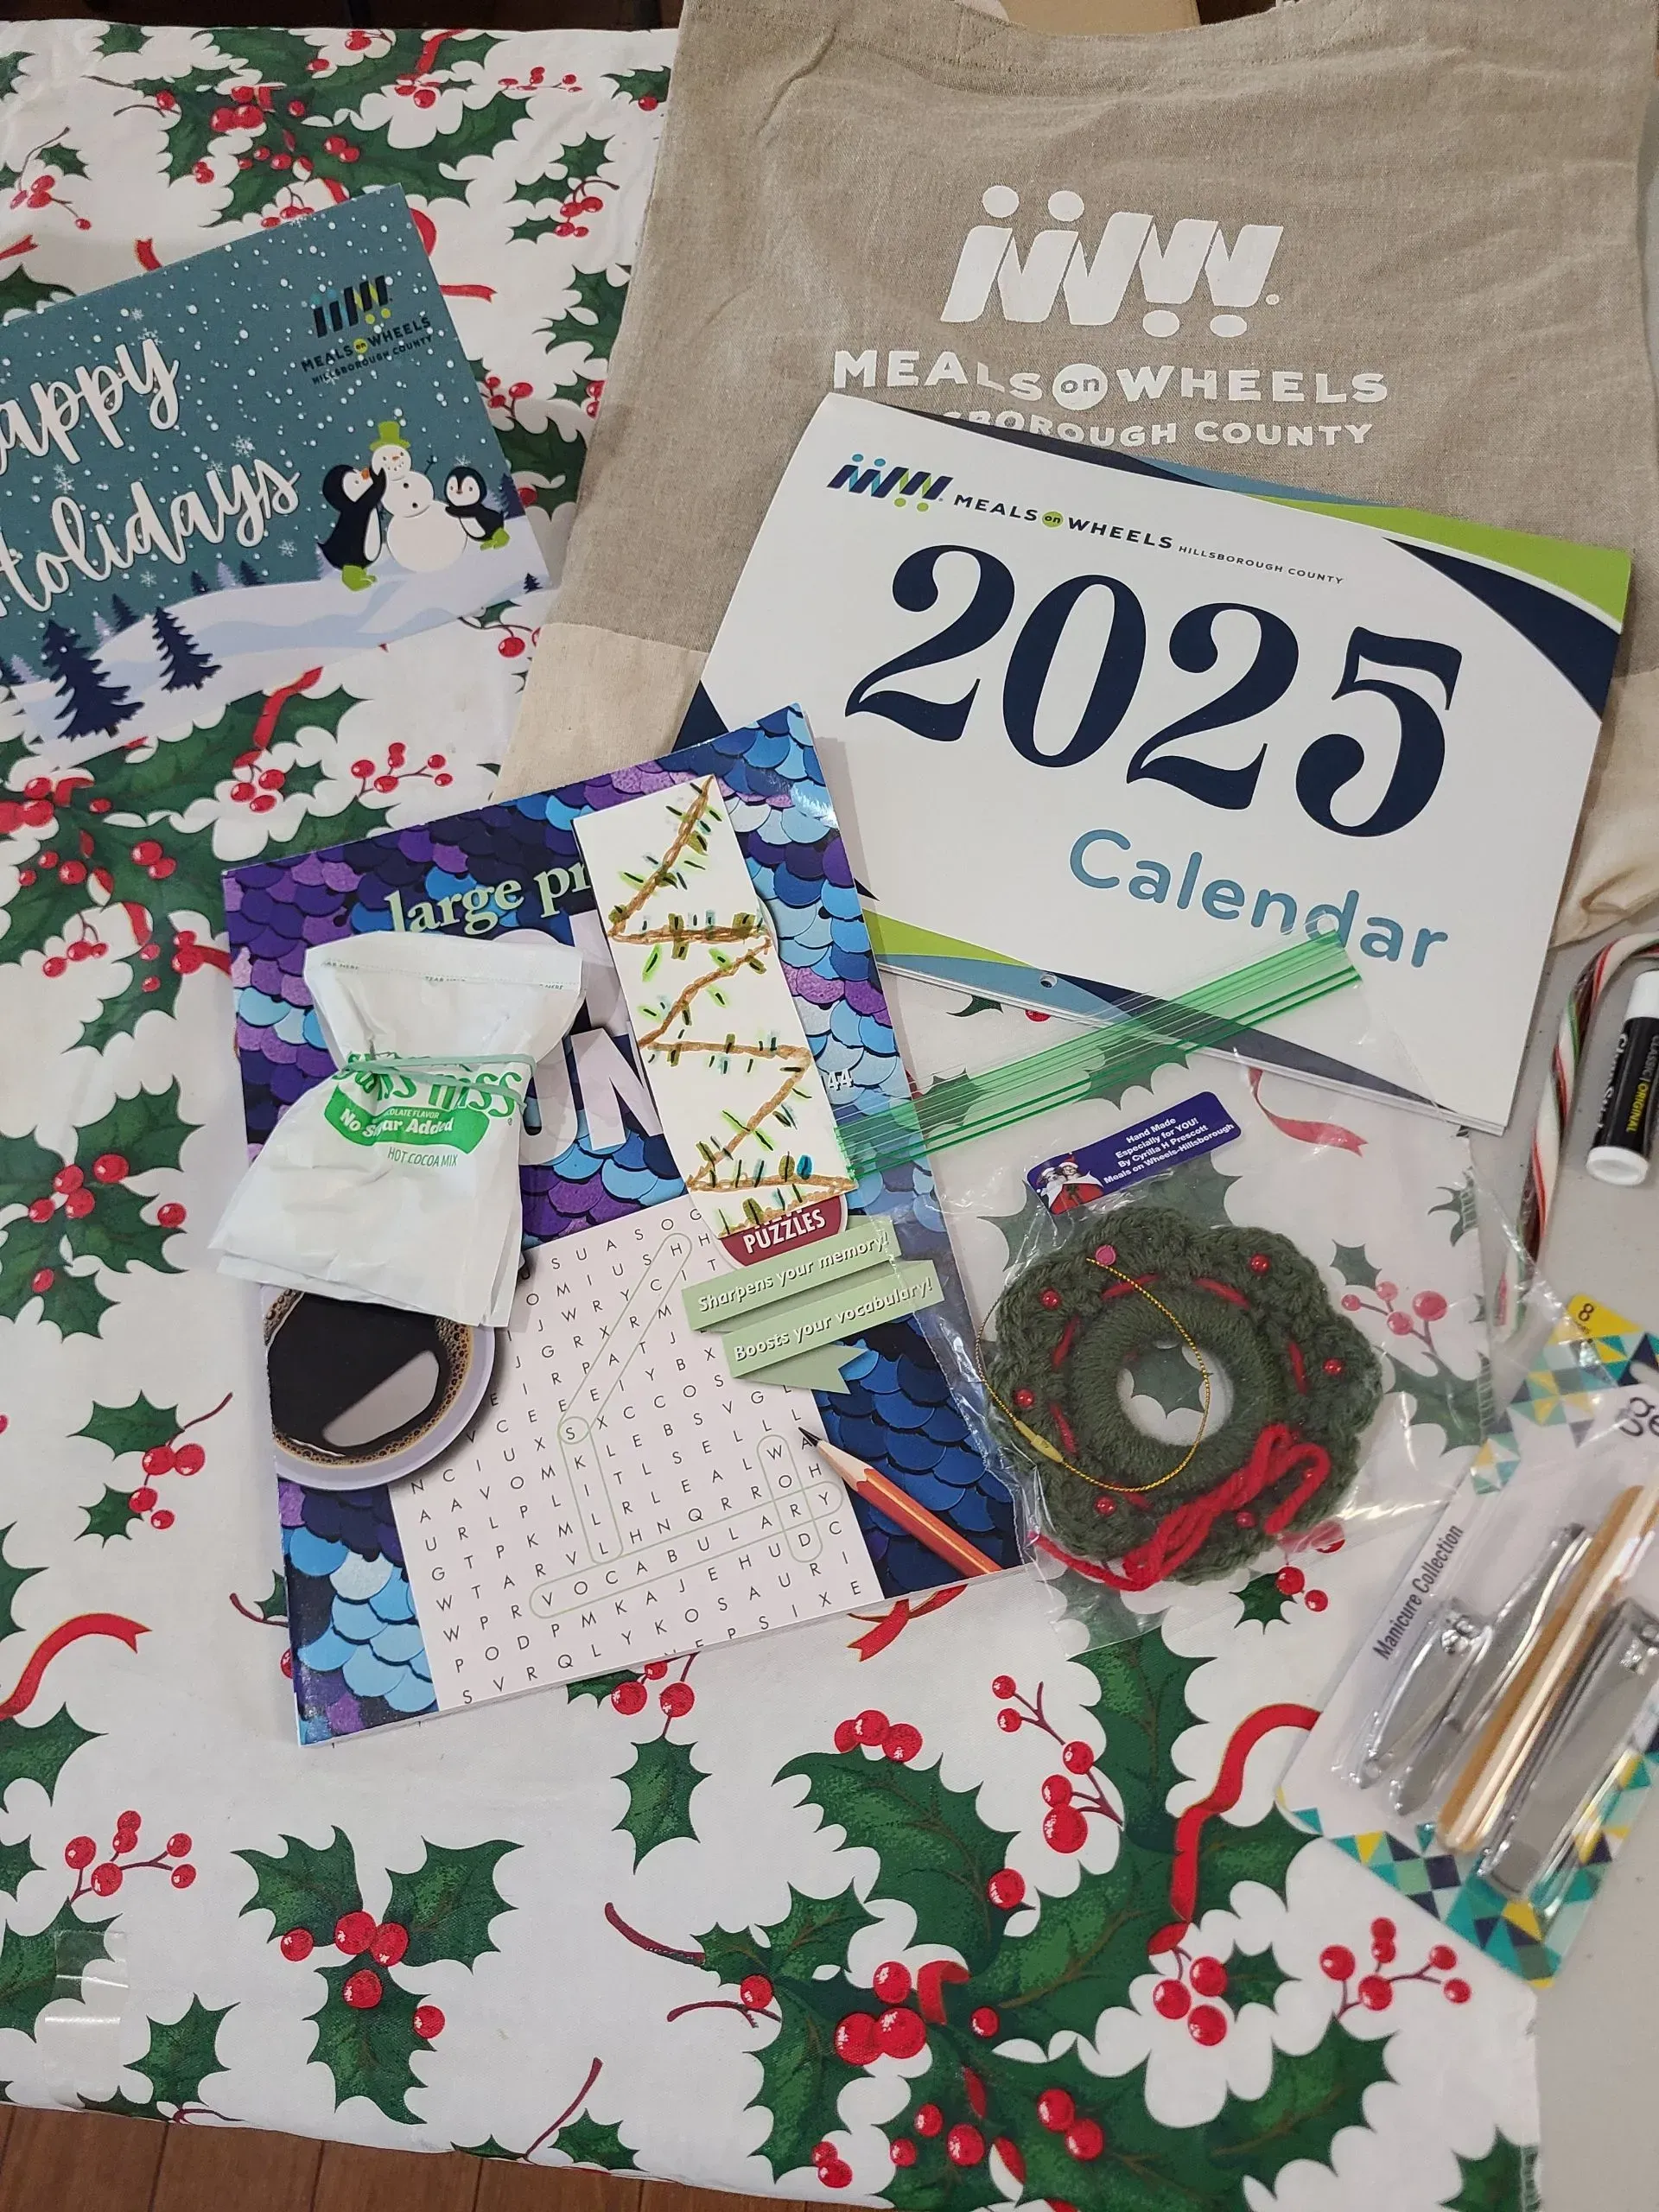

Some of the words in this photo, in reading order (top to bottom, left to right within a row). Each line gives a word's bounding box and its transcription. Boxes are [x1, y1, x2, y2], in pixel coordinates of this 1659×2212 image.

[301, 346, 353, 372] MEALS
[367, 316, 431, 347] WHEELS
[392, 334, 433, 355] COUNTY
[0, 338, 180, 476] appy
[833, 349, 1043, 401] MEALS
[1059, 377, 1101, 394] on
[1116, 365, 1388, 404] WHEELS
[943, 410, 1177, 447] BOROUGH
[1194, 420, 1373, 447] COUNTY
[953, 494, 1039, 522] MEALS
[1068, 517, 1173, 550] WHEELS
[1178, 545, 1283, 573] HILLSBOROUGH
[1287, 568, 1344, 585] COUNTY
[845, 544, 1463, 837] 2025
[384, 880, 525, 936] large
[1069, 829, 1448, 969] Calendar
[340, 1108, 361, 1132] No
[405, 1117, 453, 1135] Added
[412, 1109, 440, 1119] FLAVOR
[1115, 1135, 1161, 1159] Especially
[1160, 1128, 1176, 1140] for
[1173, 1117, 1200, 1135] YOU!
[1126, 1128, 1151, 1144] Hand
[1151, 1116, 1177, 1133] Made
[1625, 1081, 1650, 1133] ORIGINAL
[388, 1147, 406, 1164] HOT
[407, 1153, 441, 1167] COCOA
[440, 1154, 458, 1166] MIX
[1103, 1169, 1133, 1185] Meals
[1131, 1164, 1145, 1173] on
[1144, 1123, 1236, 1166] Wheels-Hillsborough
[1117, 1158, 1132, 1168] By
[1131, 1145, 1161, 1164] Cyrilla
[1161, 1141, 1170, 1150] H
[1169, 1124, 1209, 1148] Prescott
[550, 1257, 561, 1270] S
[575, 1247, 588, 1262] U
[606, 1238, 618, 1252] A
[634, 1228, 644, 1241] S
[660, 1218, 674, 1231] O
[690, 1208, 702, 1221] G
[742, 1208, 826, 1255] PUZZLES
[526, 1293, 540, 1306] O
[556, 1281, 571, 1298] M
[612, 1262, 624, 1277] U
[642, 1253, 652, 1267] S
[670, 1242, 683, 1257] H
[697, 1232, 711, 1248] H
[697, 1275, 774, 1313] Sharpens
[776, 1261, 813, 1287] your
[818, 1231, 889, 1269] memory!
[734, 1328, 791, 1362] Boosts
[793, 1315, 831, 1343] your
[835, 1276, 933, 1324] vocabulary!
[1578, 1302, 1595, 1322] 8
[424, 1536, 437, 1552] U
[457, 1526, 469, 1541] R
[488, 1516, 499, 1529] L
[519, 1504, 528, 1519] P
[551, 1494, 562, 1508] L
[613, 1471, 623, 1485] T
[641, 1462, 652, 1476] L
[671, 1451, 683, 1465] S
[702, 1440, 712, 1454] E
[733, 1430, 744, 1443] L
[761, 1419, 772, 1433] L
[791, 1408, 802, 1421] L
[431, 1567, 446, 1581] G
[463, 1554, 474, 1570] T
[495, 1544, 505, 1560] P
[526, 1532, 539, 1548] K
[558, 1521, 574, 1538] M
[590, 1513, 601, 1526] L
[621, 1500, 633, 1516] R
[650, 1491, 661, 1504] L
[680, 1478, 692, 1494] E
[712, 1469, 724, 1484] A
[741, 1458, 753, 1471] L
[766, 1444, 782, 1461] W
[435, 1594, 453, 1611] W
[470, 1584, 481, 1599] T
[503, 1574, 516, 1590] A
[535, 1563, 547, 1578] R
[565, 1550, 577, 1567] V
[598, 1541, 609, 1555] L
[629, 1528, 643, 1545] H
[656, 1517, 671, 1535] N
[688, 1507, 704, 1522] Q
[720, 1497, 733, 1511] R
[750, 1485, 763, 1500] R
[778, 1474, 792, 1489] O
[808, 1462, 823, 1478] H
[442, 1624, 460, 1643] W
[480, 1615, 489, 1631] P
[511, 1604, 523, 1619] R
[541, 1592, 553, 1607] V
[573, 1580, 588, 1596] O
[605, 1570, 619, 1585] C
[636, 1560, 649, 1576] A
[666, 1548, 678, 1564] B
[696, 1535, 710, 1552] U
[728, 1527, 740, 1541] L
[760, 1514, 773, 1530] A
[789, 1503, 802, 1518] R
[817, 1491, 829, 1506] Y
[454, 1658, 464, 1674] P
[485, 1645, 499, 1662] O
[517, 1635, 530, 1651] D
[550, 1623, 560, 1638] P
[581, 1611, 597, 1629] M
[614, 1599, 628, 1616] K
[645, 1590, 658, 1606] A
[707, 1566, 719, 1582] E
[738, 1554, 753, 1570] H
[767, 1542, 781, 1558] U
[798, 1532, 811, 1548] D
[829, 1521, 842, 1535] C
[1372, 1593, 1422, 1660] Manicure
[1411, 1524, 1465, 1593] Collection
[462, 1689, 473, 1705] S
[493, 1675, 505, 1693] V
[525, 1666, 538, 1681] R
[557, 1654, 574, 1669] Q
[590, 1643, 602, 1658] L
[620, 1630, 632, 1646] Y
[654, 1618, 668, 1636] K
[684, 1608, 699, 1624] O
[717, 1597, 728, 1611] S
[749, 1586, 761, 1601] A
[778, 1572, 791, 1588] U
[809, 1562, 822, 1577] R
